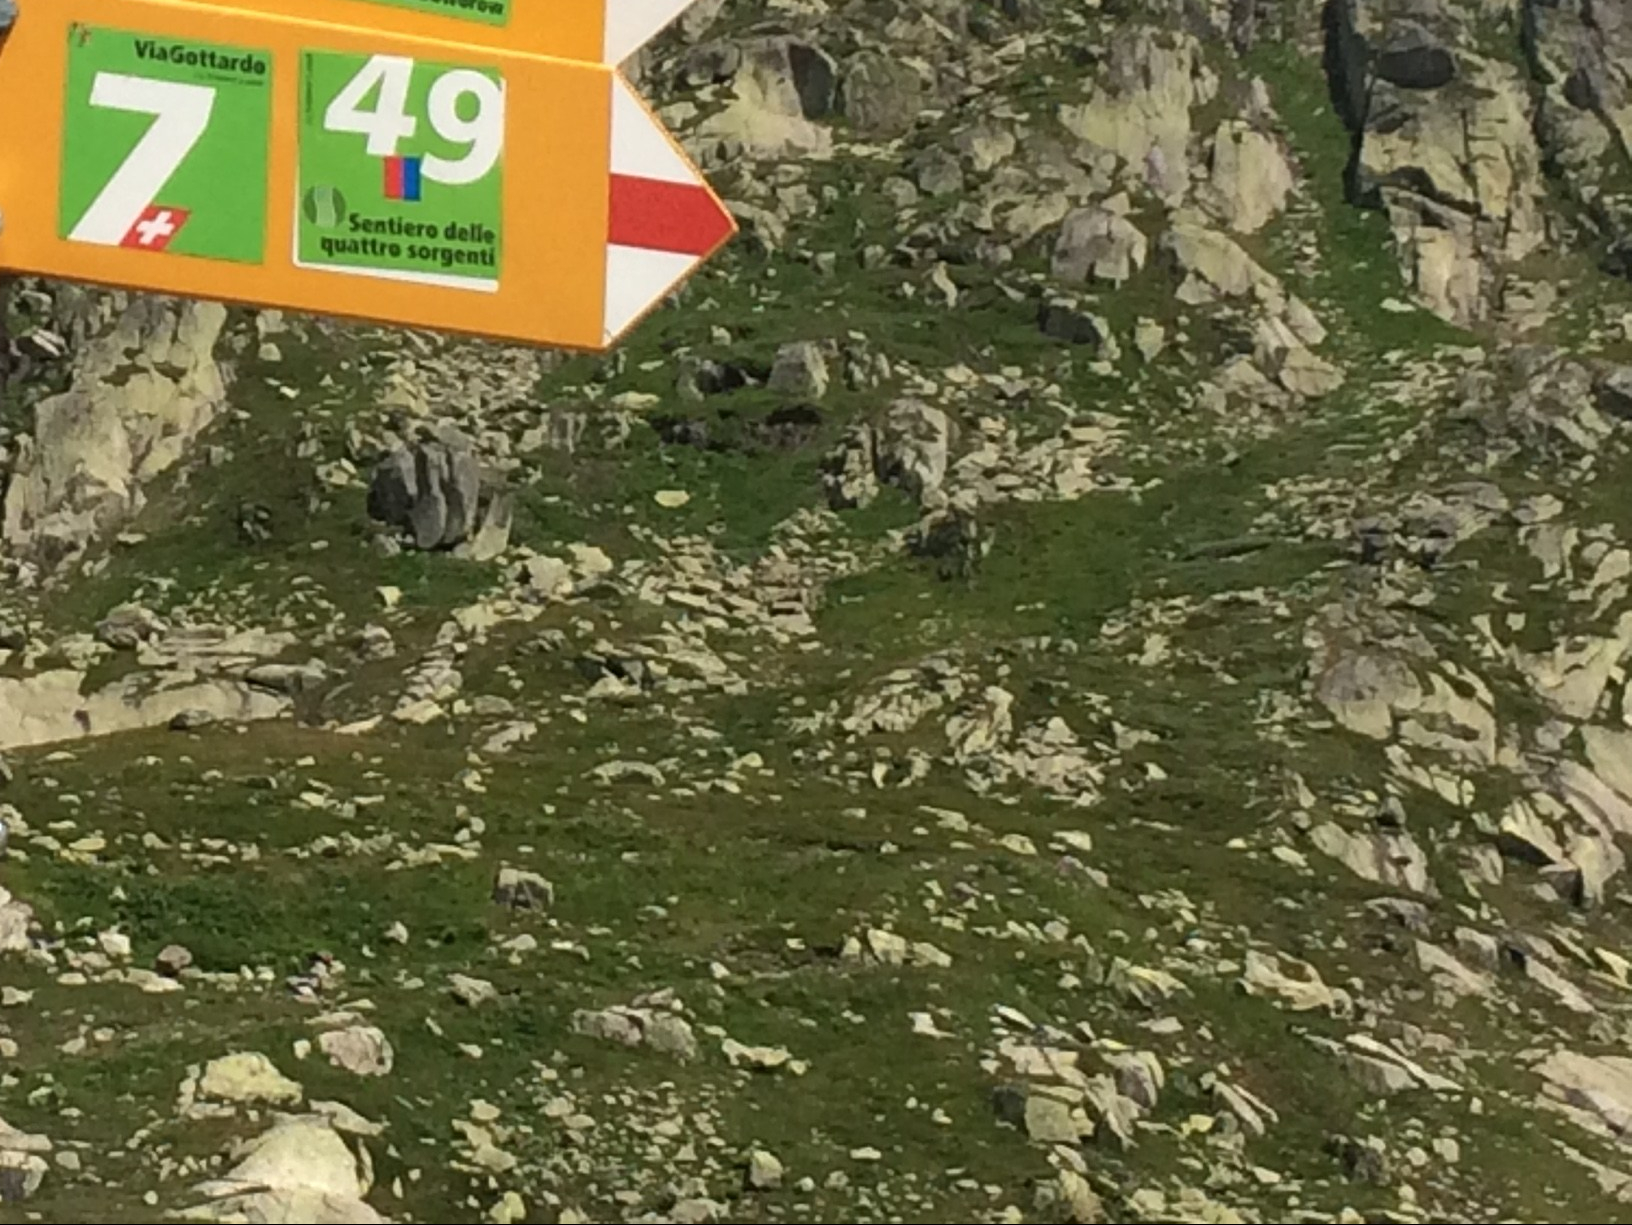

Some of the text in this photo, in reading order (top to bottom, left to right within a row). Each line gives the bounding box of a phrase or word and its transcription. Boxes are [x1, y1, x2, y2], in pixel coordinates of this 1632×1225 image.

[135, 40, 266, 75] ViaGottardo
[323, 54, 504, 185] 49
[68, 71, 217, 246] 7
[349, 213, 496, 244] Sentiero delle
[321, 236, 496, 267] quattro sorgenti
